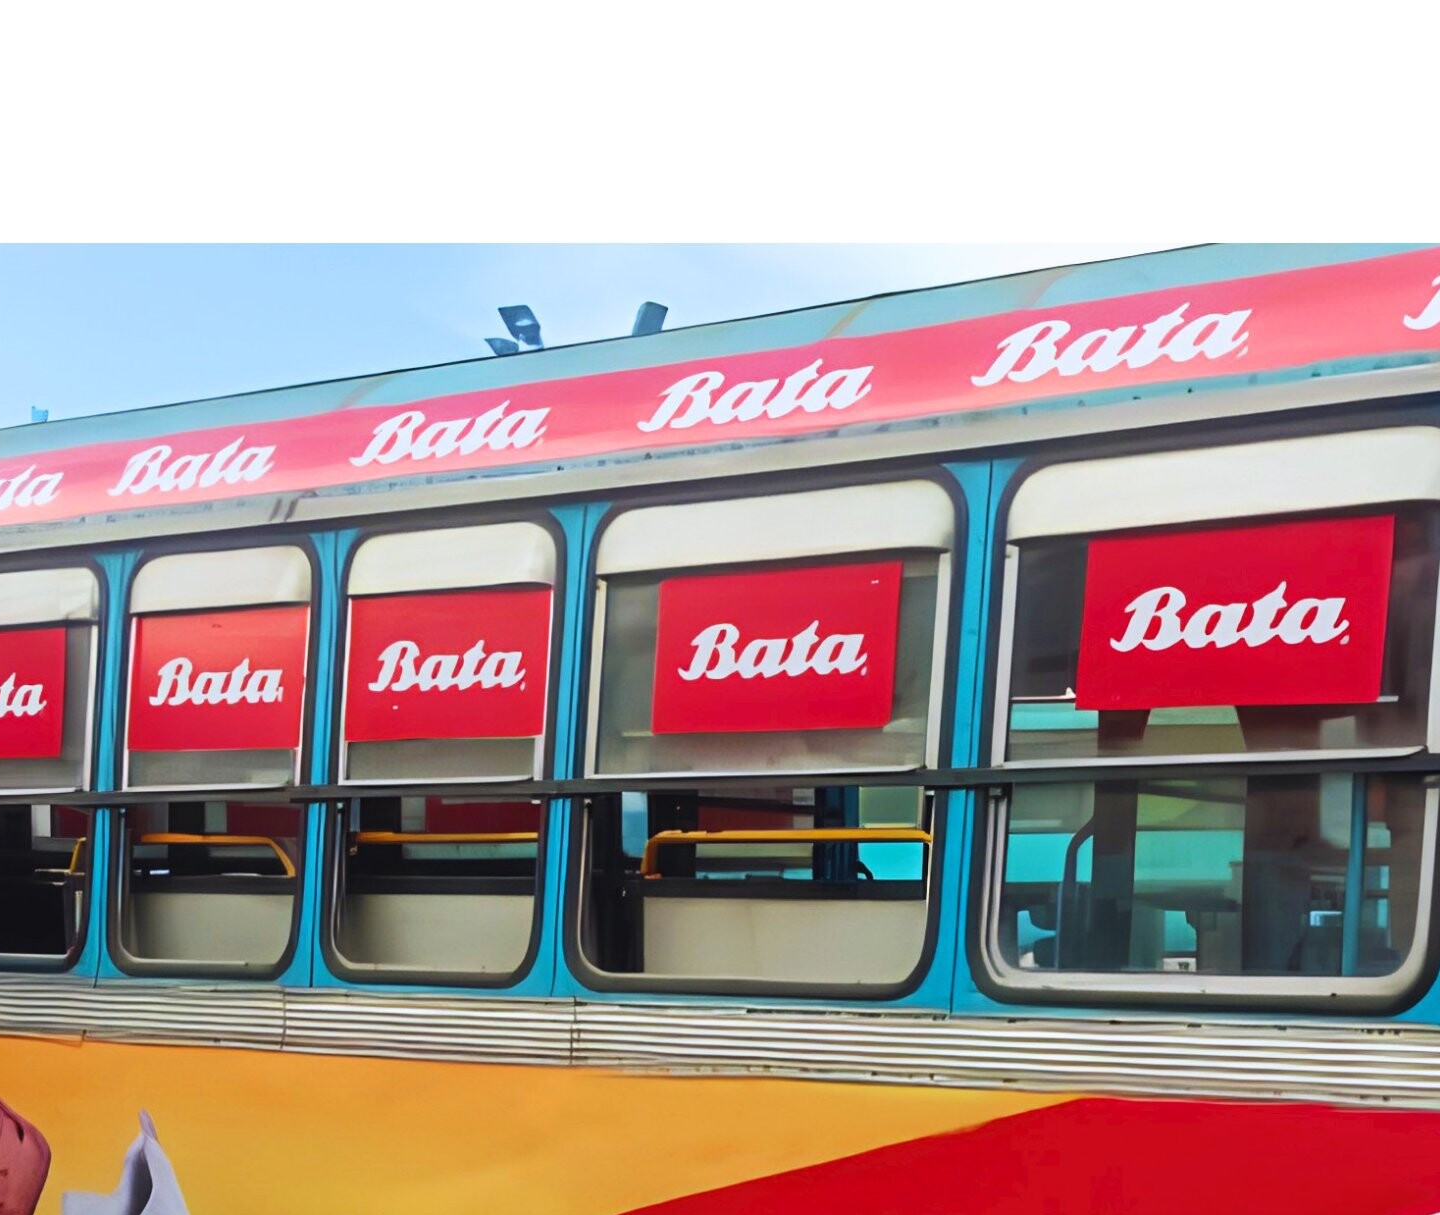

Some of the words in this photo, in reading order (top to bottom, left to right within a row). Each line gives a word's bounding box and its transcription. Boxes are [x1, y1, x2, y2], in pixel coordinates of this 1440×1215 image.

[971, 302, 1251, 387] Bata
[637, 358, 874, 433] Bata
[108, 435, 277, 496] Bata
[349, 401, 551, 467] Bata
[1110, 581, 1350, 652] Bata
[149, 657, 283, 706] Bata
[368, 639, 526, 692] Bata
[678, 620, 867, 681] Bata
